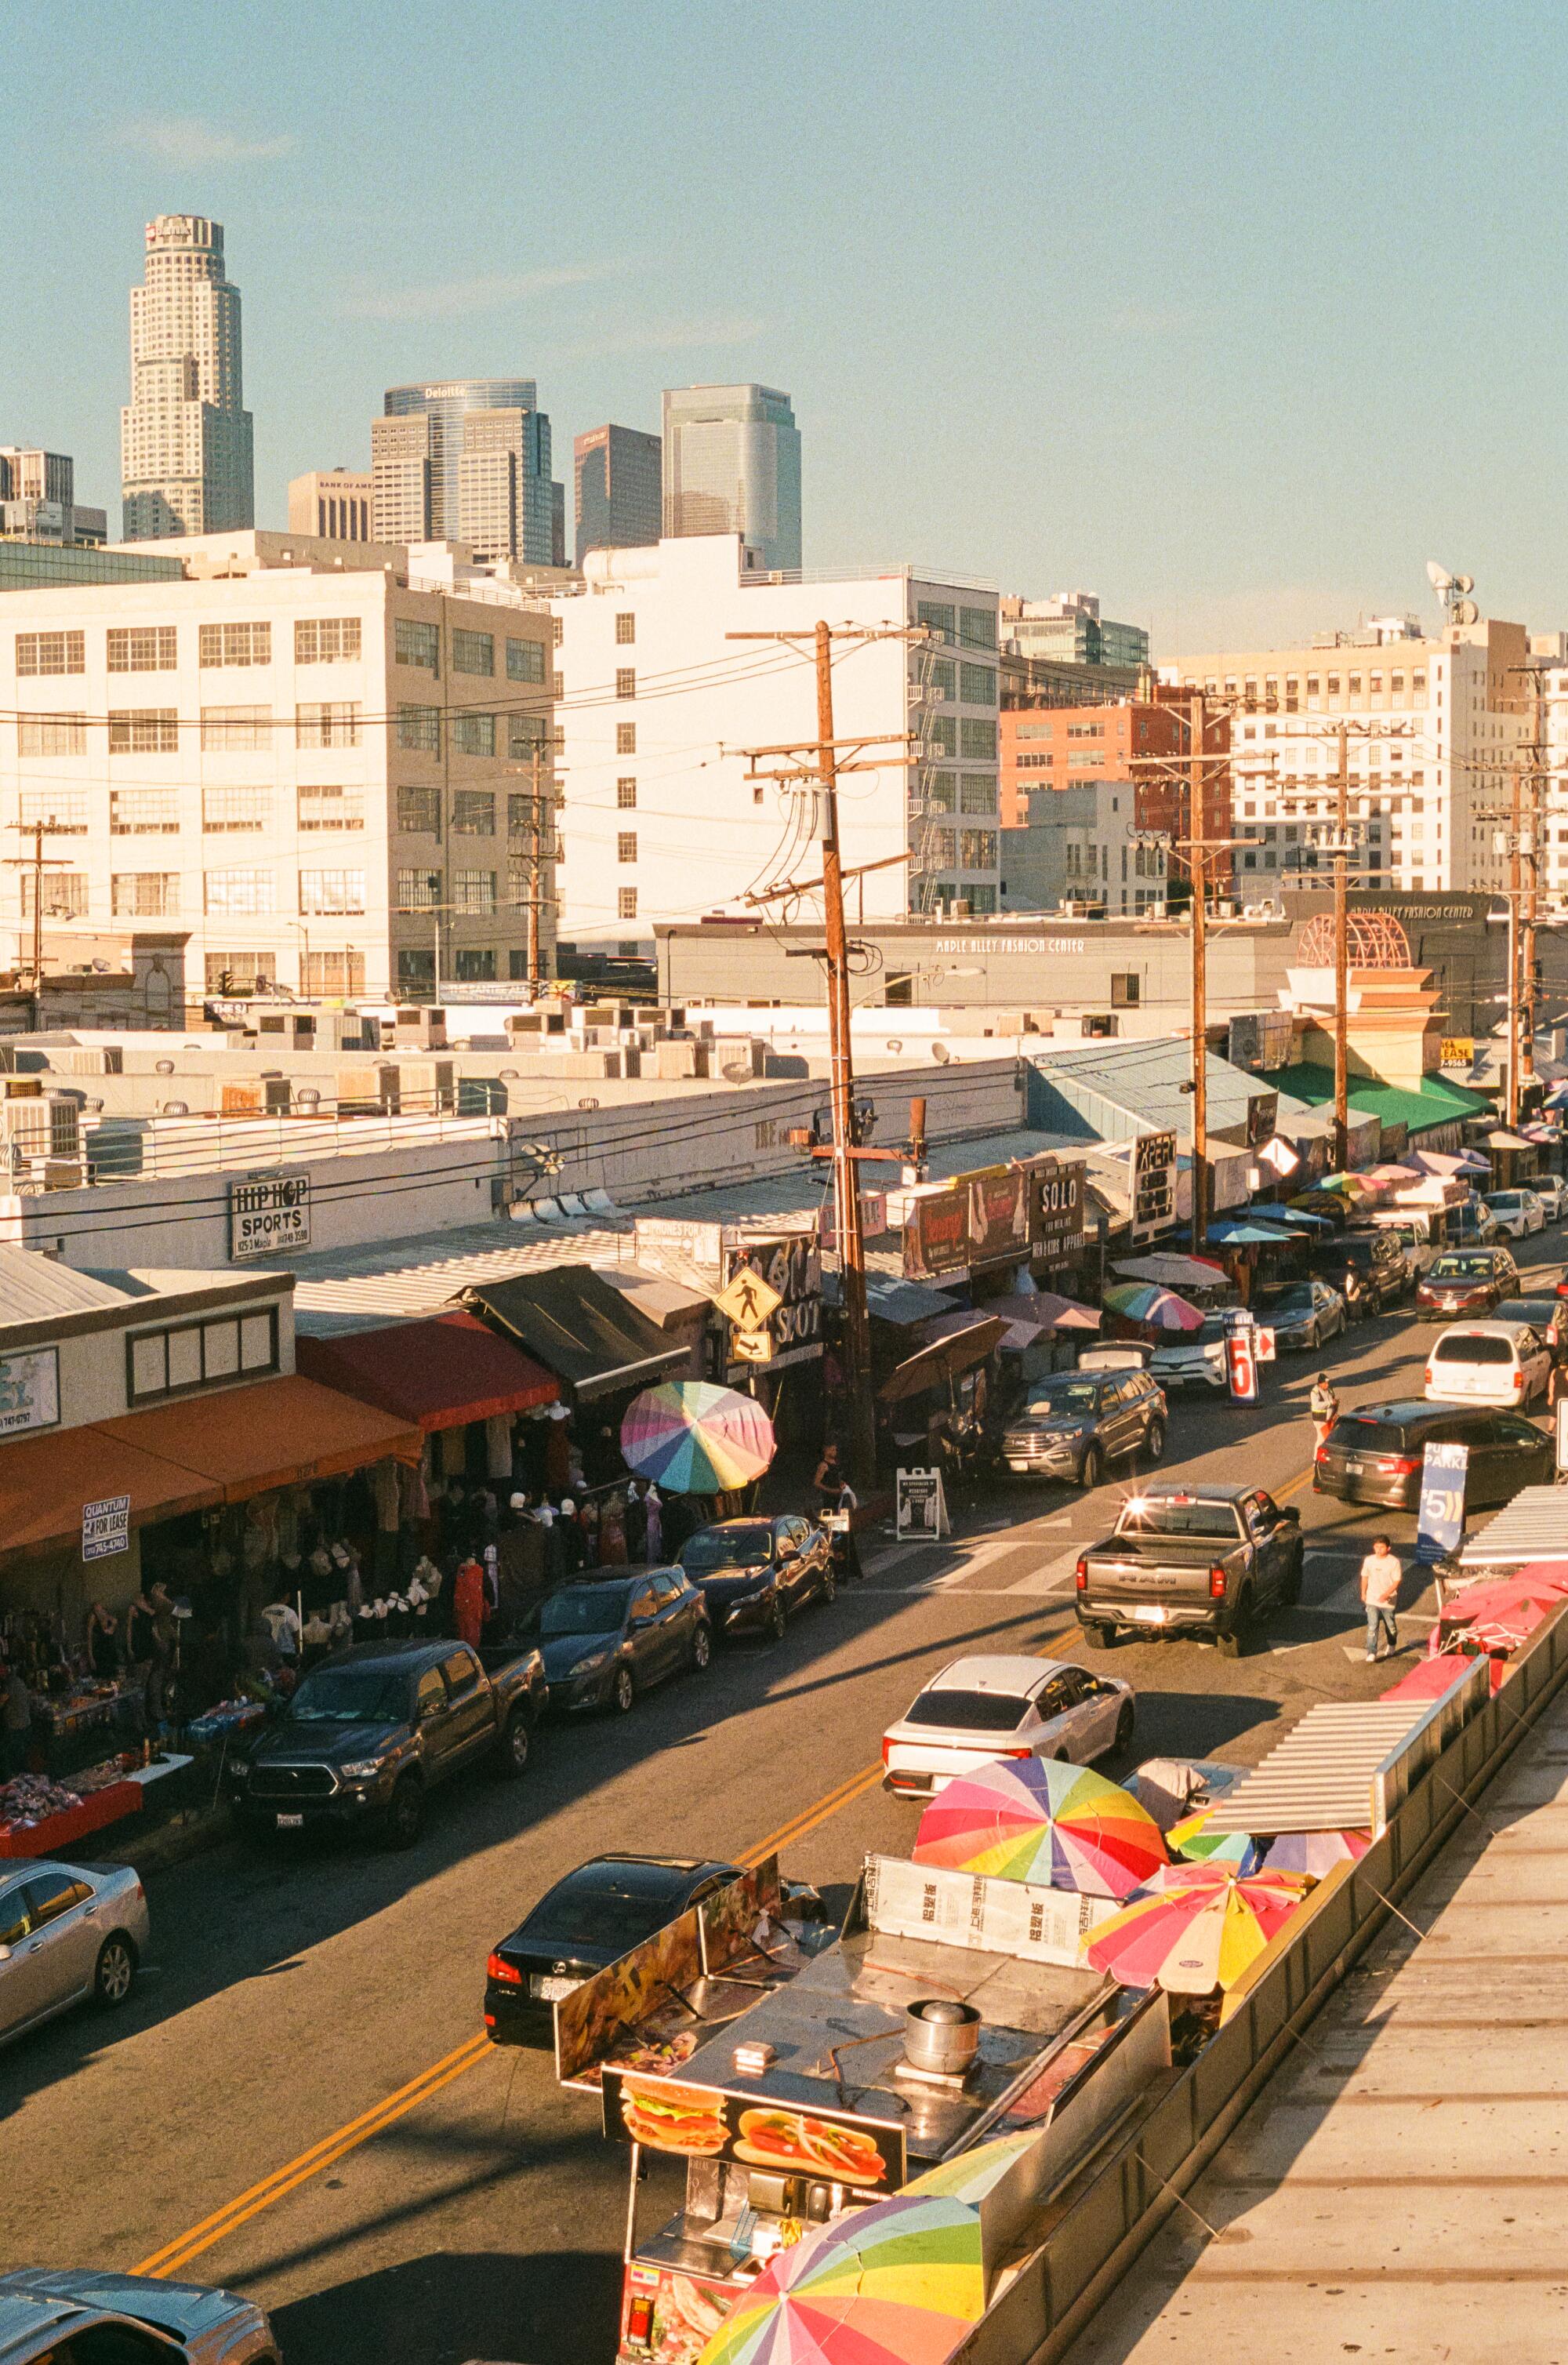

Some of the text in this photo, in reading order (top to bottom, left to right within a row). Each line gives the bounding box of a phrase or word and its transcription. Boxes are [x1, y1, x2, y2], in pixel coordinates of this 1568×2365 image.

[426, 387, 466, 398] Deloitte
[1404, 906, 1442, 918] FASHION
[1443, 905, 1474, 917] CENTER
[936, 939, 1084, 953] MAPLE ALLEY FASHION CENTER
[213, 1004, 234, 1013] THE
[1440, 1048, 1469, 1058] EASE
[237, 1179, 307, 1212] HIP HOP
[1042, 1179, 1076, 1213] SOLO
[242, 1210, 301, 1237] SPORTS
[1229, 1339, 1250, 1395] 5
[4, 1412, 31, 1426] 747-0797
[85, 1499, 126, 1518] QUANTUM
[96, 1518, 108, 1535] FOR
[110, 1513, 127, 1531] LEASE
[1119, 1574, 1176, 1584] RAM
